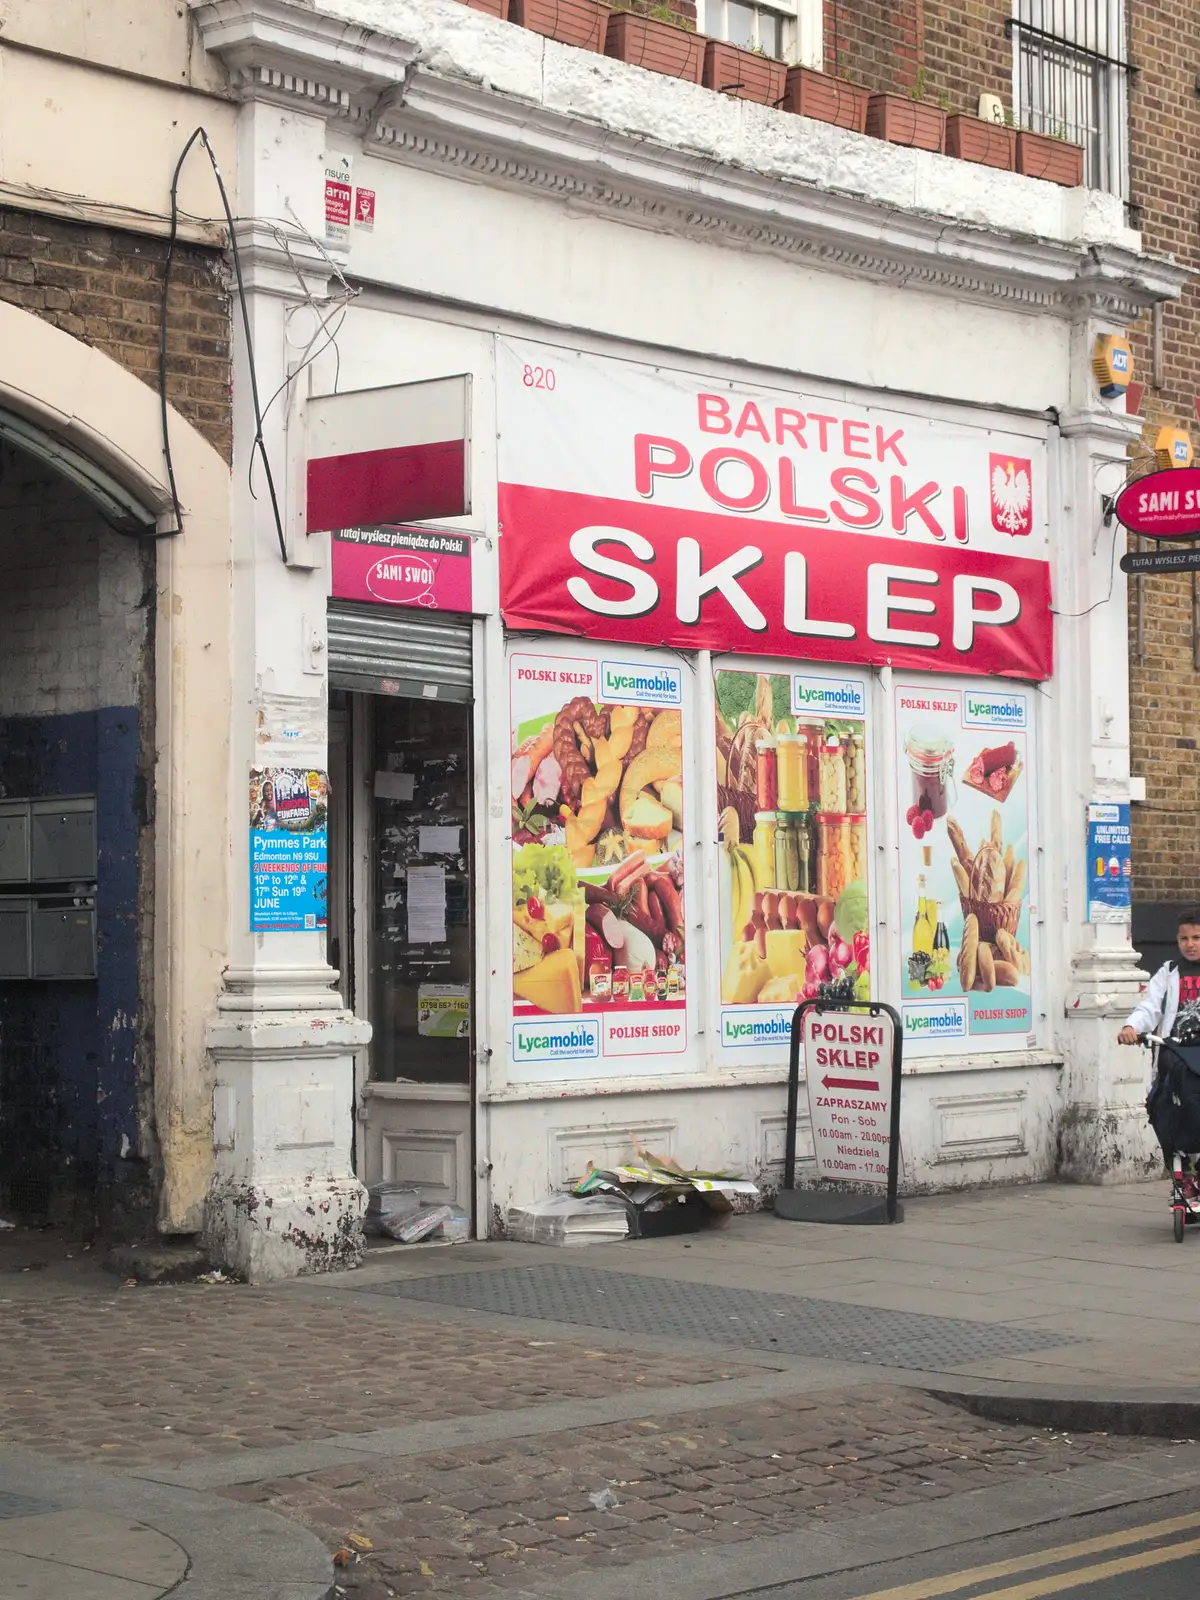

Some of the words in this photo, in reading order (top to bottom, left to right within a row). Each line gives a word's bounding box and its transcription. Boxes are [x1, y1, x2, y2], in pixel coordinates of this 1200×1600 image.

[1112, 353, 1128, 371] ADT
[523, 364, 556, 391] 820
[697, 393, 908, 467] BARTEK
[634, 433, 969, 544] POLSKI
[1138, 490, 1180, 513] SAMI
[361, 530, 391, 544] wyślesz
[391, 532, 428, 549] pieniądze
[429, 537, 440, 550] do
[440, 538, 464, 553] Polski
[1132, 558, 1153, 567] TUTAJ
[1188, 554, 1200, 563] PIE
[376, 563, 402, 581] SAMI
[405, 567, 433, 585] SWOI
[566, 525, 1022, 654] SKLEP
[518, 668, 557, 682] POLSKI
[559, 671, 593, 685] SKLEP
[606, 671, 677, 692] Lycamobile
[798, 684, 861, 704] Lycamobile
[900, 698, 931, 710] POLSKI
[932, 701, 958, 712] SKLEP
[968, 700, 1023, 717] Lycamobile
[277, 808, 310, 819] FUNFAIRS
[1096, 825, 1130, 835] UNLIMITED
[253, 836, 300, 851] Pymmes
[302, 836, 327, 849] Park
[1095, 834, 1111, 844] FREE
[1111, 835, 1131, 844] CALLS
[253, 852, 291, 861] Edmonton
[293, 852, 303, 861] N9
[304, 852, 319, 861] 9SU
[254, 862, 259, 873] 2
[260, 863, 300, 873] WEEKENDS
[302, 863, 311, 873] OF
[313, 863, 327, 873] FUN
[254, 874, 270, 885] 10th
[271, 875, 281, 885] to
[283, 874, 299, 885] 12th
[300, 875, 307, 885] &
[254, 886, 270, 897] 17th
[271, 886, 290, 897] Sun
[291, 886, 307, 897] 19th
[254, 898, 280, 909] JUNE
[973, 1009, 1003, 1020] POLISH
[1005, 1008, 1028, 1019] SHOP
[726, 1019, 792, 1039] Lycamobile
[905, 1013, 963, 1032] Lycamobile
[609, 1026, 650, 1039] POLISH
[652, 1024, 681, 1037] SHOP
[811, 1023, 884, 1047] POLSKI
[518, 1030, 594, 1053] Lycamobile
[816, 1048, 881, 1070] SKLEP
[816, 1097, 888, 1112] ZAPRASZAMY
[831, 1114, 850, 1125] Pon
[857, 1116, 877, 1127] Sob
[818, 1128, 853, 1140] 10.00am
[837, 1145, 880, 1158] Niedziela
[822, 1158, 857, 1171] 10.00am
